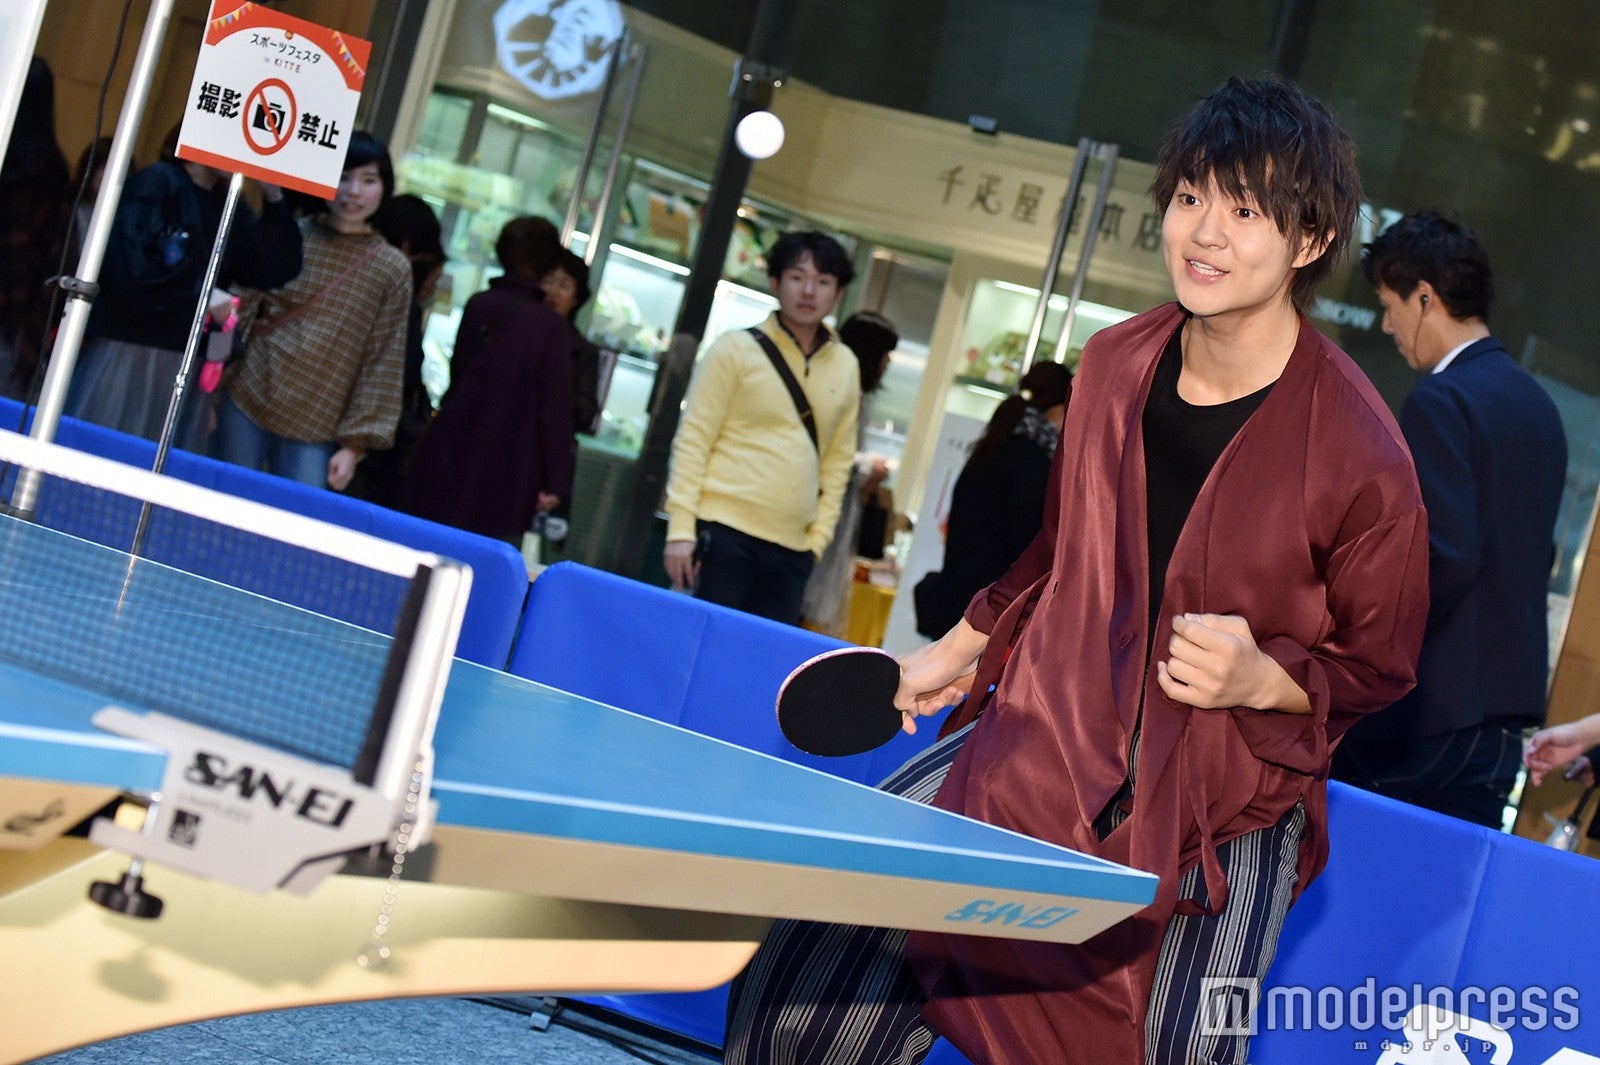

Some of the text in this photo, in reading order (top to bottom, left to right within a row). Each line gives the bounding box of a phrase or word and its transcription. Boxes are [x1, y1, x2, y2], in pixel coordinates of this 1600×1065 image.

[250, 33, 321, 64] スポーツフェスタ
[274, 58, 301, 74] KITTE
[197, 81, 339, 150] 撮影 禁止
